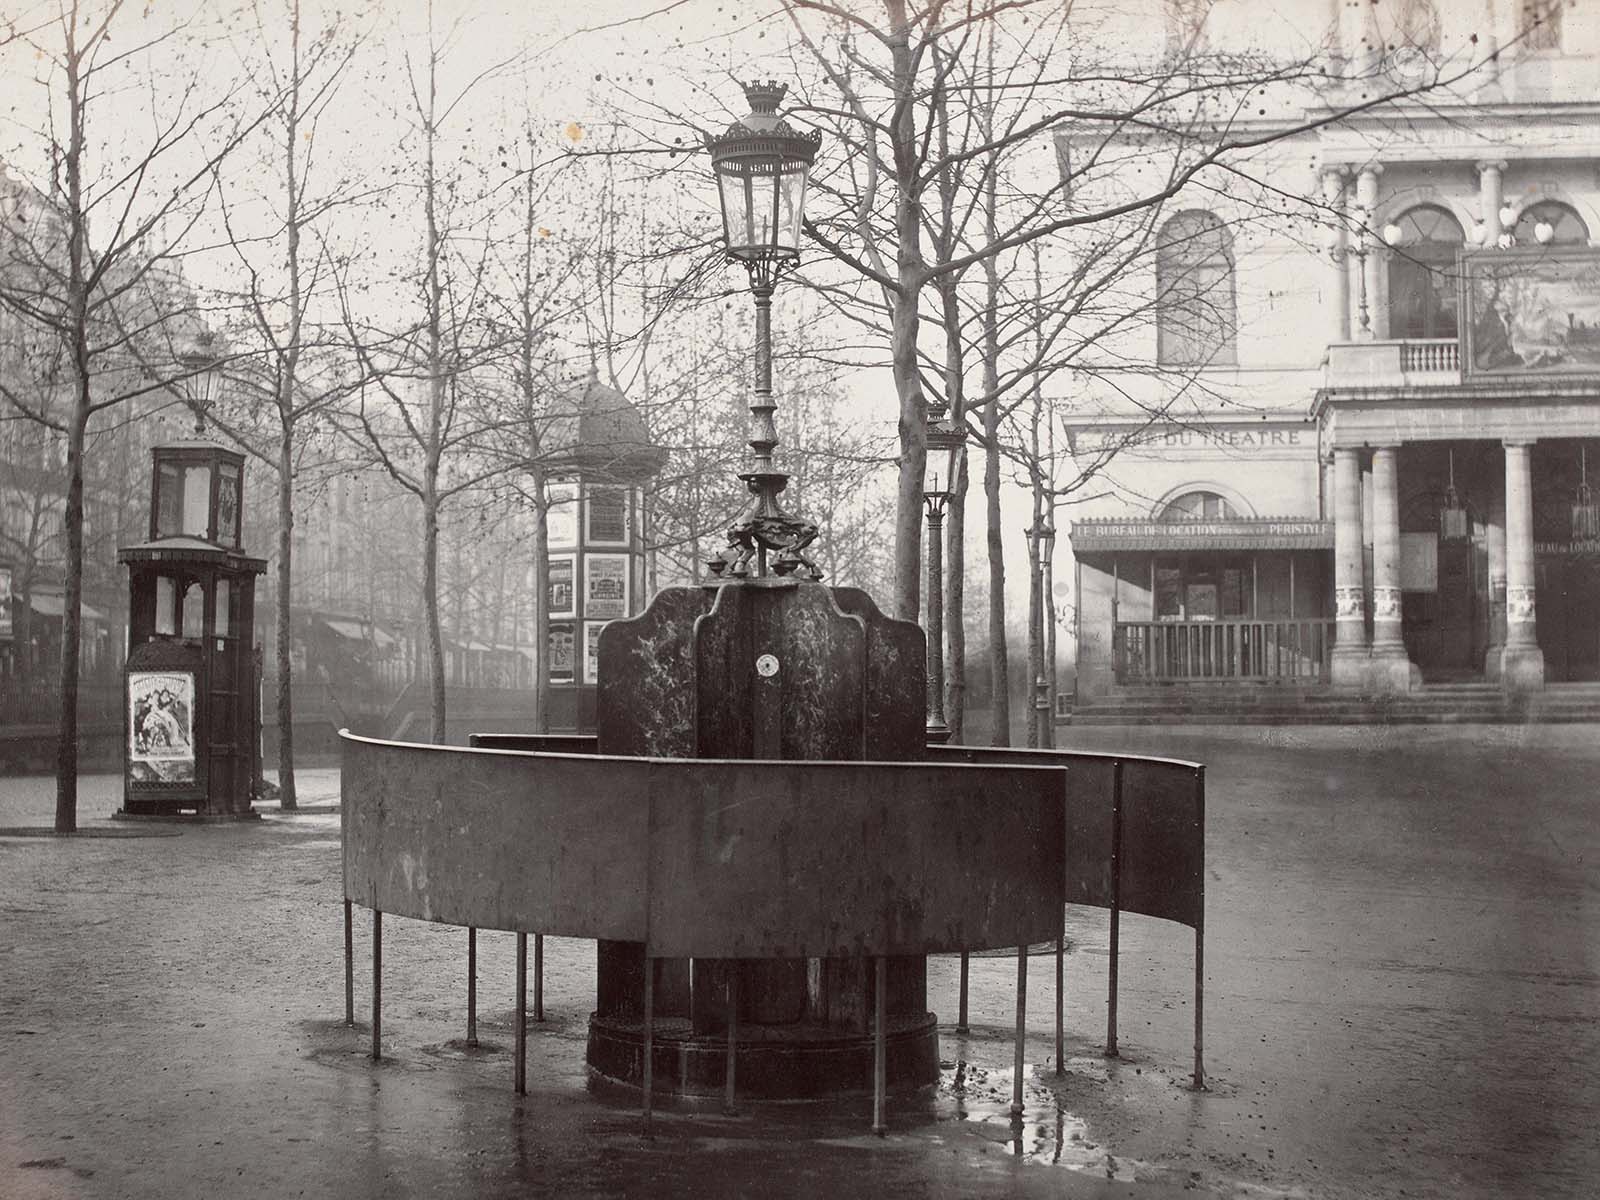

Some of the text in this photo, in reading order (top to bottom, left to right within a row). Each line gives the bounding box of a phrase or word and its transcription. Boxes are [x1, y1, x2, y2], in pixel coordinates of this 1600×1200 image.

[1076, 525, 1089, 537] LE
[1095, 525, 1140, 537] BUREAU
[1163, 524, 1217, 536] LOCATION
